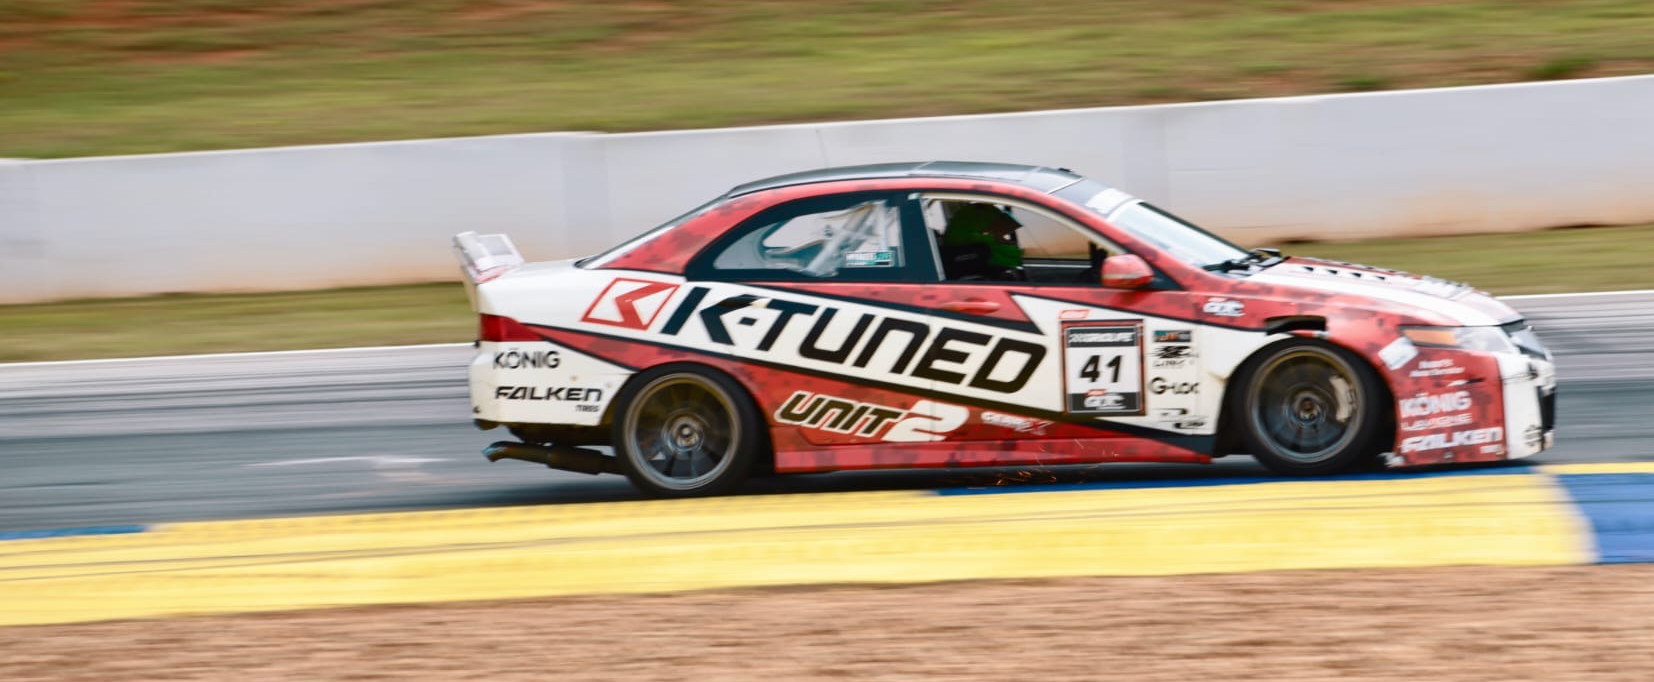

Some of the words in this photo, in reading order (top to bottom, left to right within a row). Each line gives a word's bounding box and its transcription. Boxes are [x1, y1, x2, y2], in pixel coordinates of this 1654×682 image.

[660, 286, 1047, 394] K-TUNED
[1079, 354, 1124, 383] 41
[495, 386, 603, 401] FALKEN
